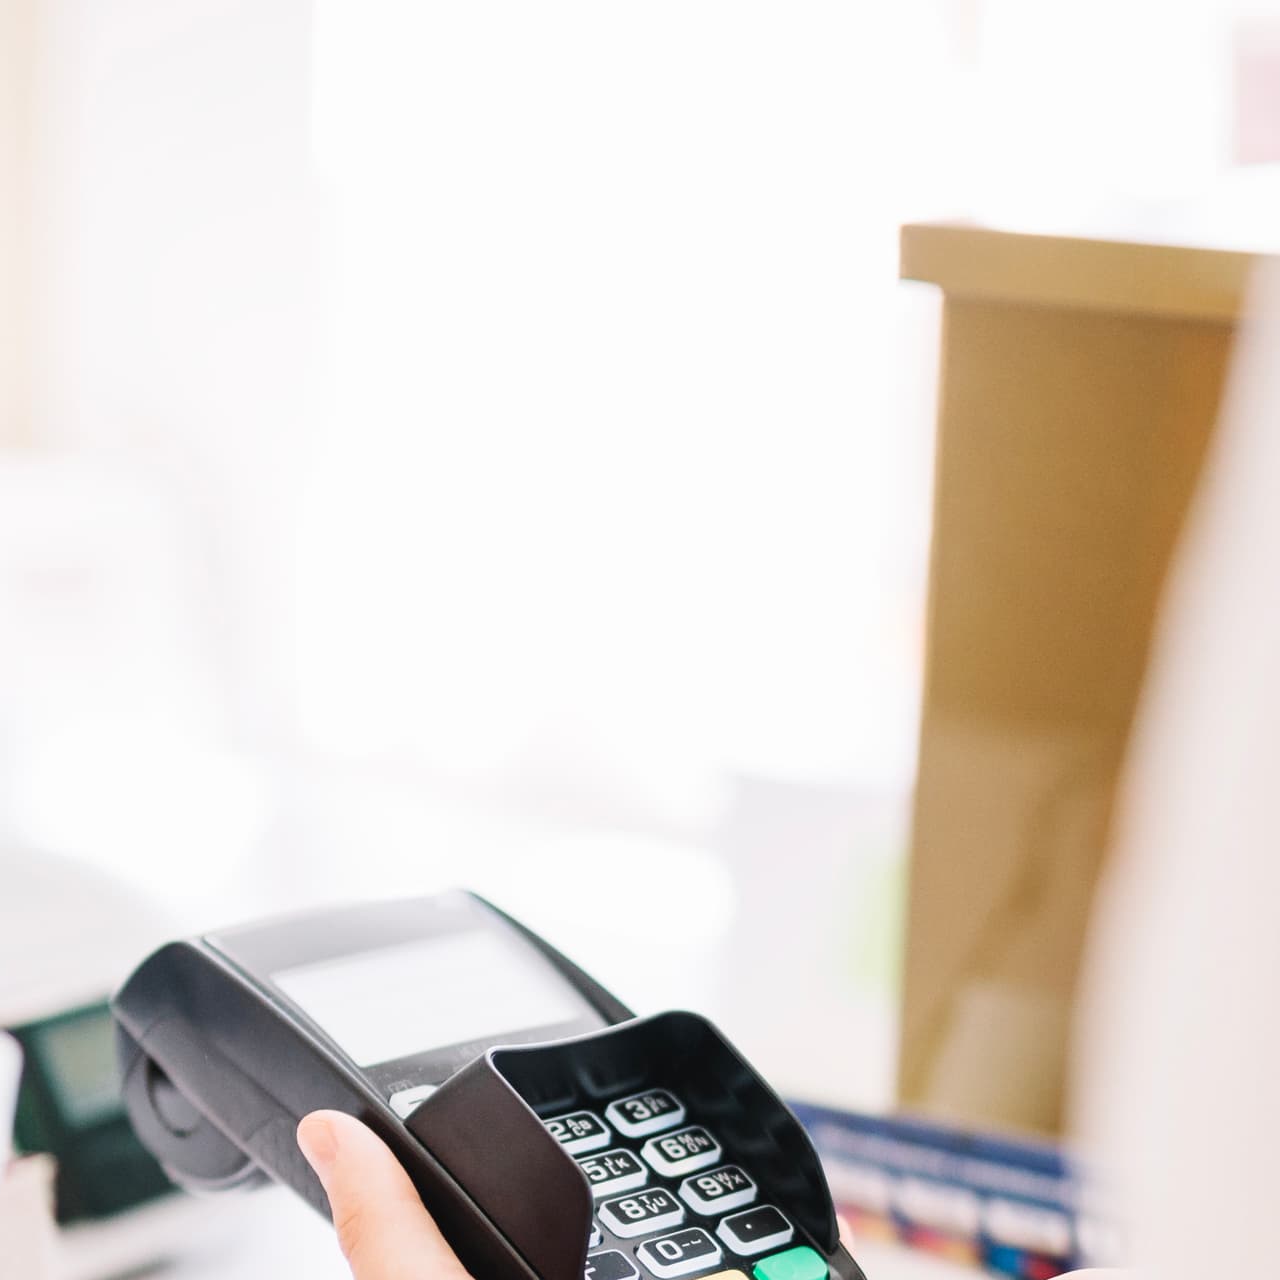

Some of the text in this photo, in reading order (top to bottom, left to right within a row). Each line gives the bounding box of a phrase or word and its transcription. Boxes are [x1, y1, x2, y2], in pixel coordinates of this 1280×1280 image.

[624, 1100, 652, 1120] 3
[545, 1121, 573, 1141] 2
[660, 1138, 687, 1159] 6
[579, 1160, 609, 1181] 5
[696, 1176, 724, 1197] 9
[618, 1199, 647, 1219] 8
